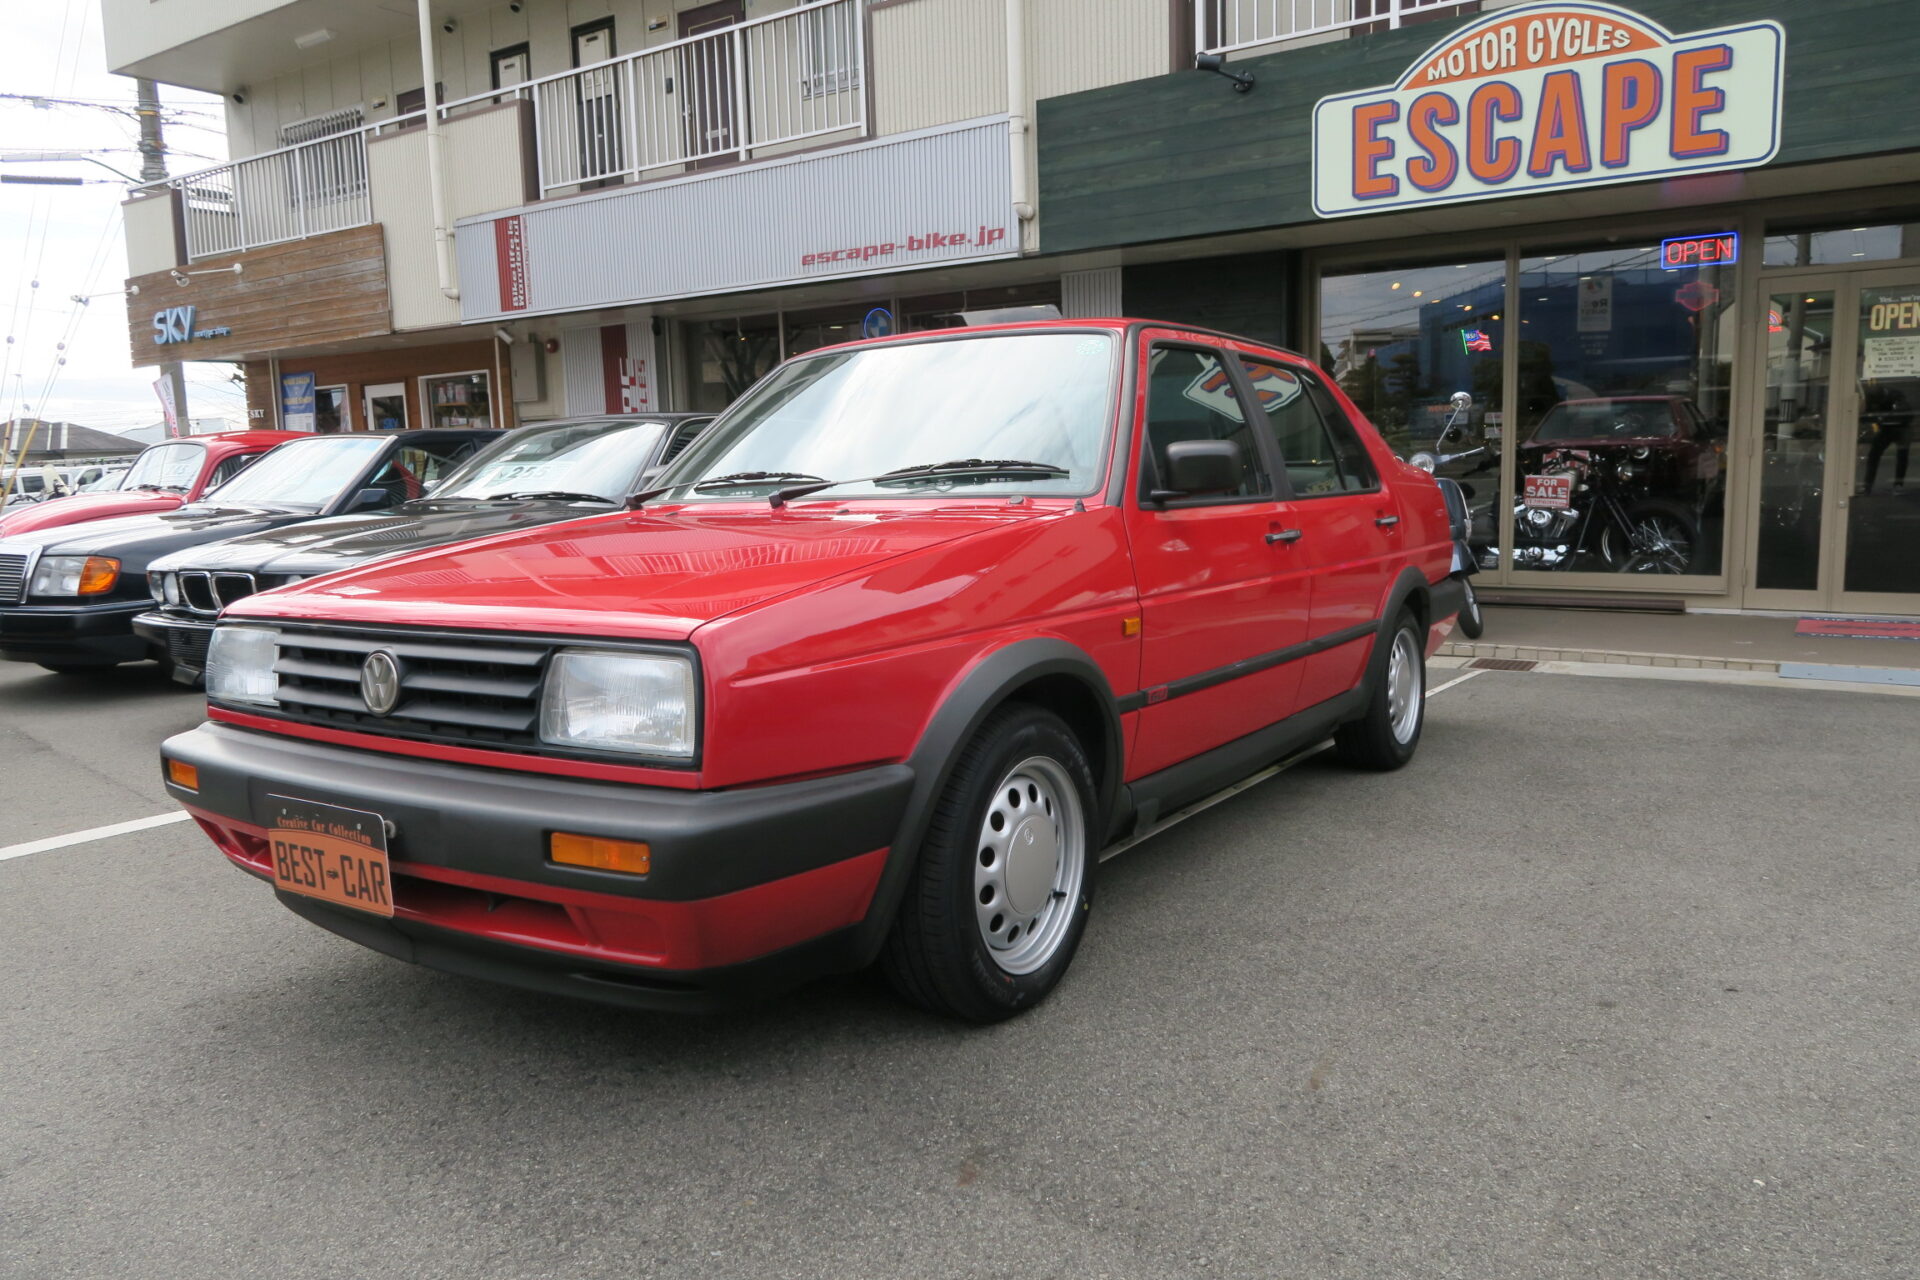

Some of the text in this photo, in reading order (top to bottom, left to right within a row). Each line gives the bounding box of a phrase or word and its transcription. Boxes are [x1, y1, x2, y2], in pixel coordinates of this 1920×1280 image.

[1427, 17, 1632, 81] MOTOR CYCLES
[1352, 43, 1732, 199] ESCAPE
[802, 226, 1005, 266] escape-bike.jp
[1667, 237, 1733, 264] OPEN
[513, 220, 525, 306] Wonderful
[154, 305, 196, 344] SKY
[1870, 302, 1920, 331] OPEN
[248, 409, 265, 419] SKY
[1526, 485, 1568, 498] SALE
[1536, 478, 1558, 486] FOR
[311, 819, 326, 834] Car
[328, 822, 373, 846] Collection
